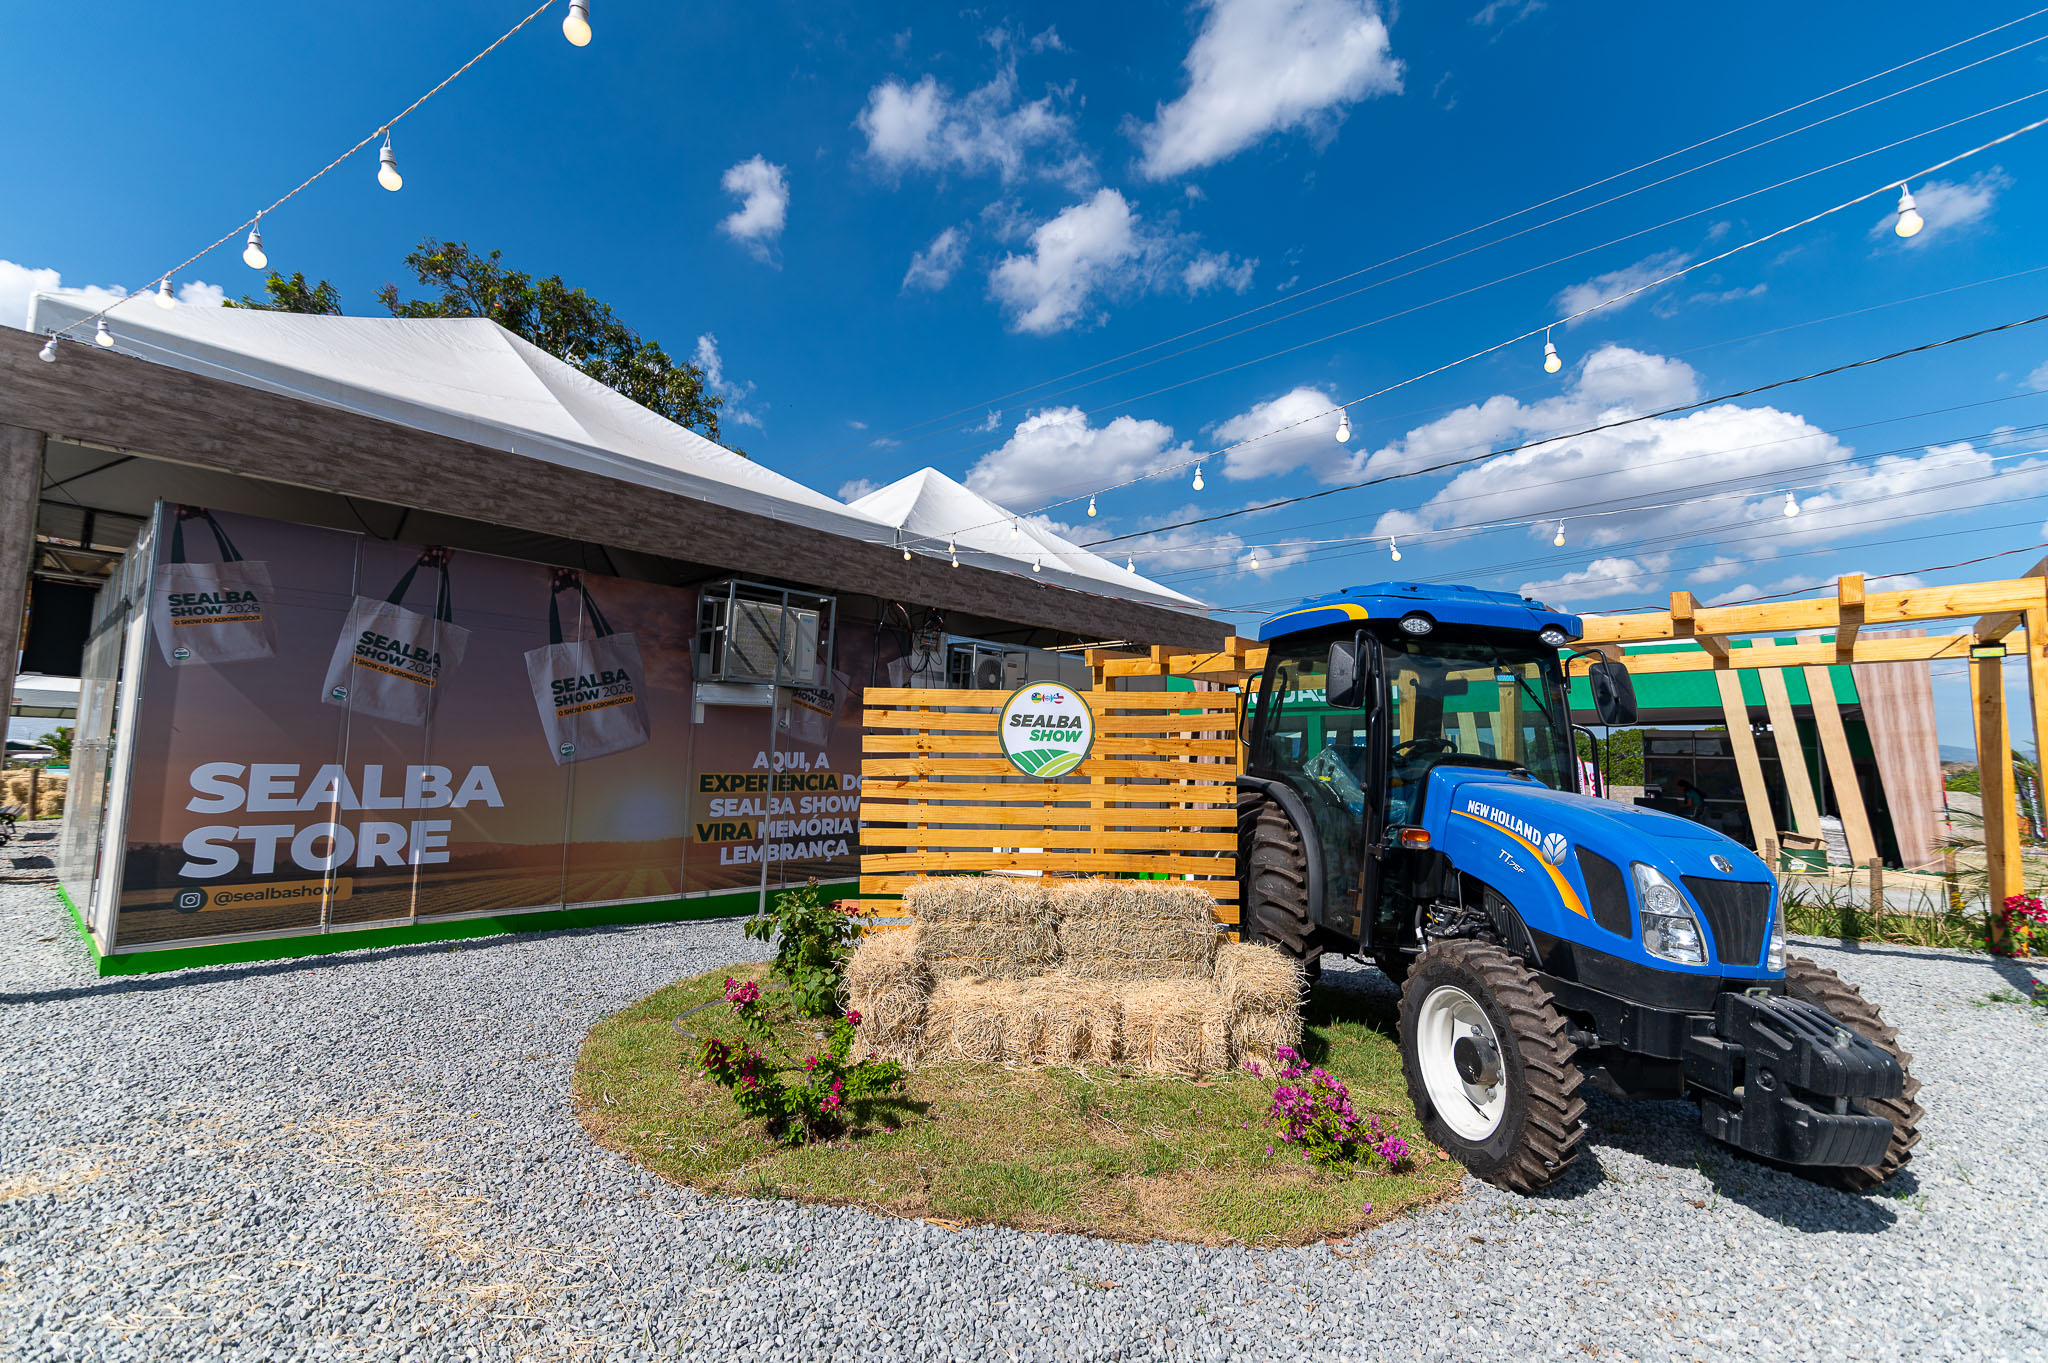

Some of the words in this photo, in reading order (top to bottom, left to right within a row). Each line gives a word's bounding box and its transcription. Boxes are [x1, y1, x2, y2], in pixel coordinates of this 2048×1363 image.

[168, 591, 258, 607] SEALBA
[170, 605, 222, 617] SHOW
[226, 603, 261, 614] 2026
[355, 644, 406, 667] SHOW
[407, 660, 440, 678] 2026
[359, 631, 441, 668] SEALBA
[358, 659, 380, 670] SHOW
[379, 665, 390, 674] DO
[550, 669, 632, 695] SEALBA
[553, 688, 600, 707] SHOW
[602, 682, 633, 698] 2026
[582, 704, 592, 712] DO
[1009, 714, 1082, 729] SEALBA
[1029, 729, 1083, 743] SHOW
[752, 751, 810, 773] AQUI,
[814, 752, 830, 769] A
[185, 762, 505, 814] SEALBA
[700, 770, 838, 793] EXPERIÊNCIA
[709, 797, 795, 818] SEALBA
[800, 796, 861, 814] SHOW
[696, 822, 752, 842] VIRA
[757, 813, 853, 840] MEMÓRIA
[1467, 799, 1490, 818] NEW
[1490, 806, 1541, 846] HOLLAND
[178, 819, 451, 879] STORE
[720, 840, 849, 866] LEMBRANÇA
[213, 883, 340, 907] @sealbashow
